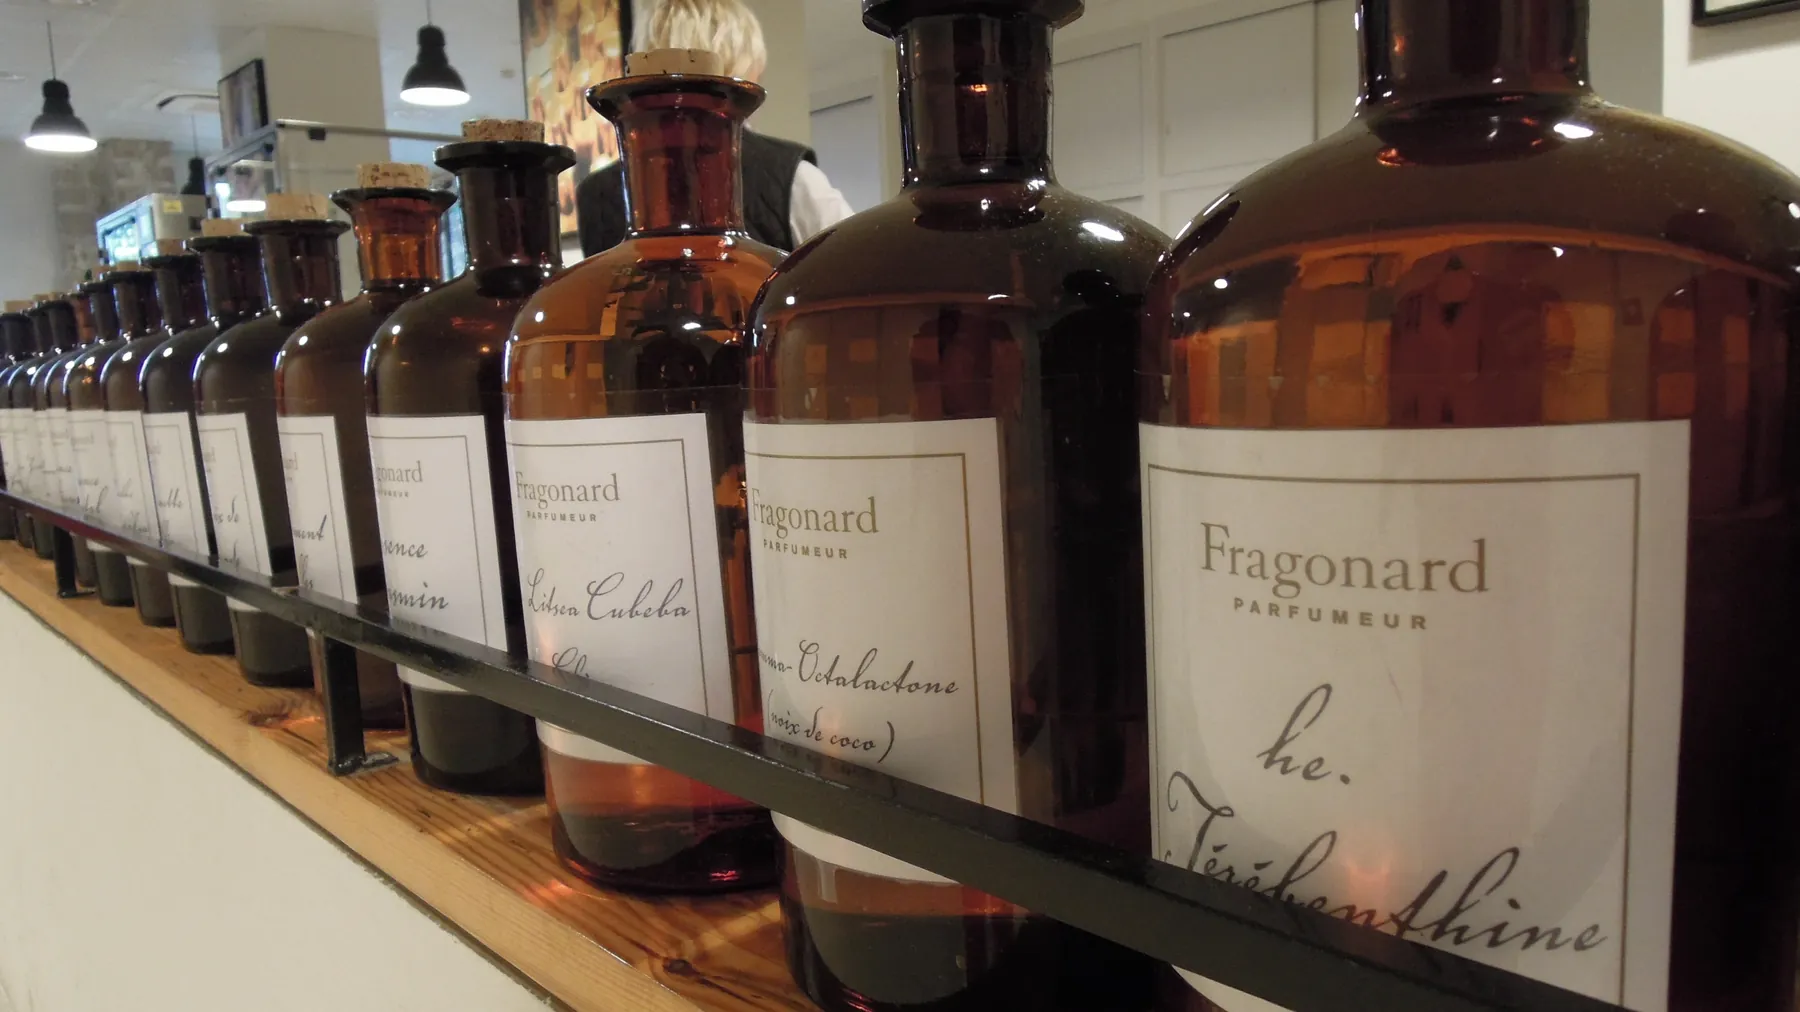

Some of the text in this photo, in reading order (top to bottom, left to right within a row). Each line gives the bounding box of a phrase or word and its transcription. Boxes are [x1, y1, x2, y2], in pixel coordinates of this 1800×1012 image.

[516, 471, 620, 510] Fragonard
[527, 510, 597, 522] PARFUMEUR
[751, 487, 879, 539] Fragonard
[764, 538, 848, 560] PARFUMEUR
[1201, 522, 1490, 599] Fragonard
[528, 568, 691, 620] Litsea Cubeba
[1234, 598, 1428, 630] PARFUMEUR
[804, 706, 824, 742] de
